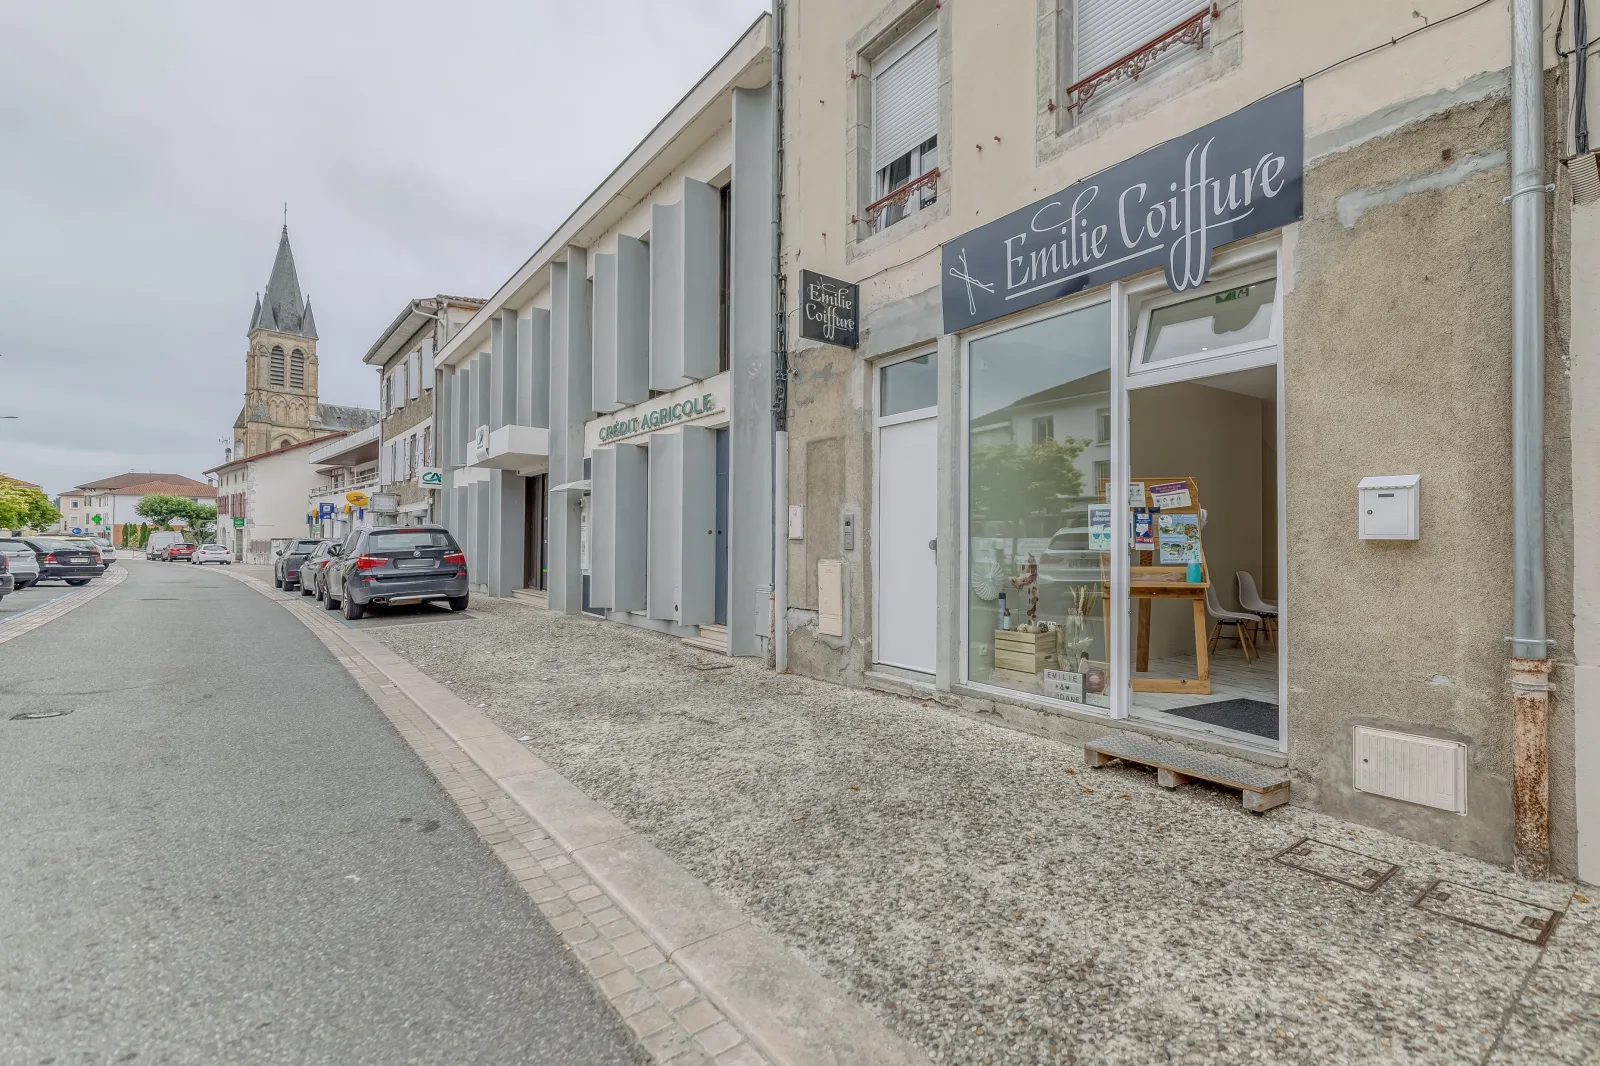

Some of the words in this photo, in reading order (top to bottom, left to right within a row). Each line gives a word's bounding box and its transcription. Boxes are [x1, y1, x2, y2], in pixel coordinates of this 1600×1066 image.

[1004, 185, 1108, 290] Emilie
[1118, 136, 1286, 291] Coiffure
[807, 283, 852, 310] Emilie
[806, 303, 855, 340] Coiffure
[598, 417, 638, 442] CRÉDIT
[640, 393, 715, 431] AGRICOLE
[1047, 671, 1078, 683] EMILIE
